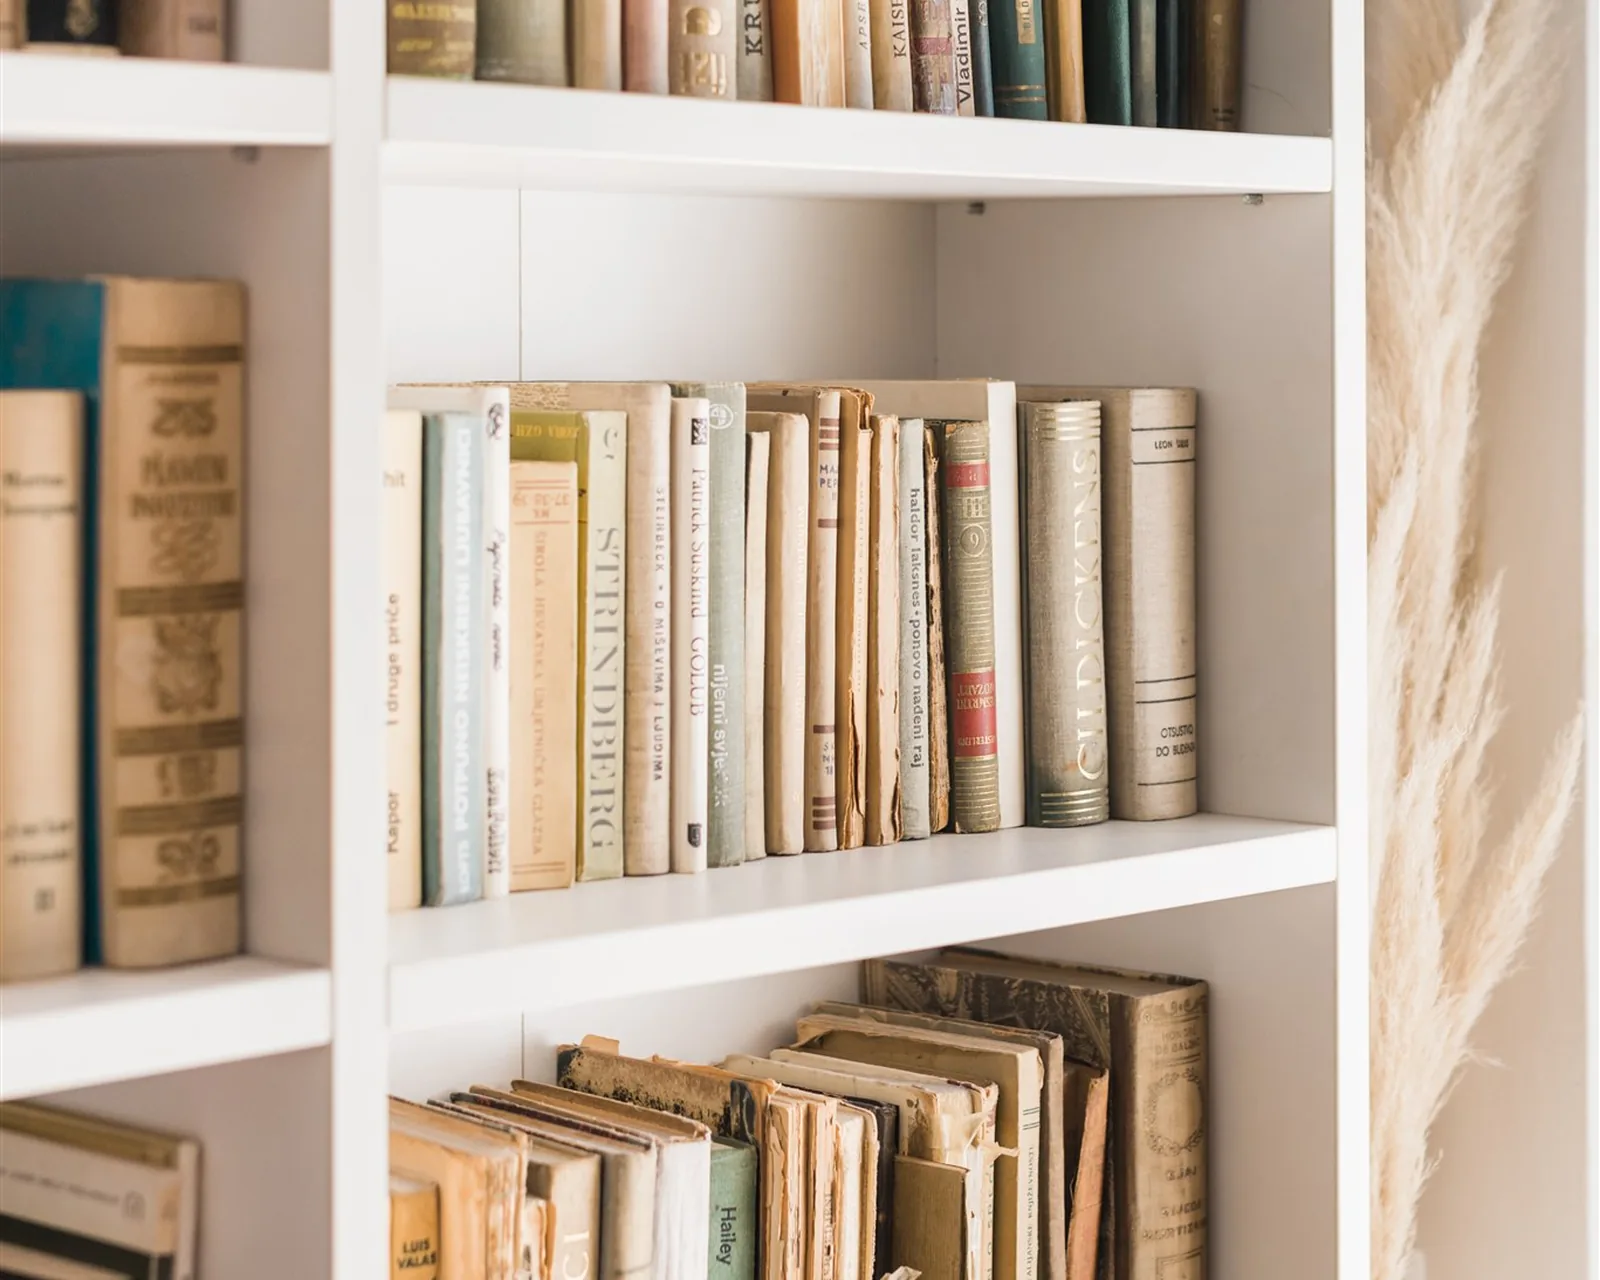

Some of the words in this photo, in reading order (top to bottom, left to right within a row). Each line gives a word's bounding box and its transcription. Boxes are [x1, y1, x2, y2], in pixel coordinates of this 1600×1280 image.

[954, 7, 972, 103] Vladimir
[453, 427, 472, 565] LJUBAVNICI
[690, 468, 707, 533] Patrick
[910, 488, 921, 540] haldor
[654, 600, 665, 609] O
[910, 547, 922, 608] laksnes
[385, 593, 401, 645] priče
[453, 573, 471, 702] NEISKRENI
[908, 619, 923, 679] ponovo
[385, 653, 402, 712] druge
[653, 617, 667, 694] MIŠEVIMA
[689, 636, 707, 717] GOLUB
[588, 526, 621, 850] STRINDBERG
[710, 664, 729, 724] nijemi
[453, 709, 471, 832] POTPUNO
[652, 716, 665, 782] LJUDIMA
[909, 745, 923, 768] raj
[1155, 746, 1170, 757] DO
[716, 1206, 737, 1265] Hailey
